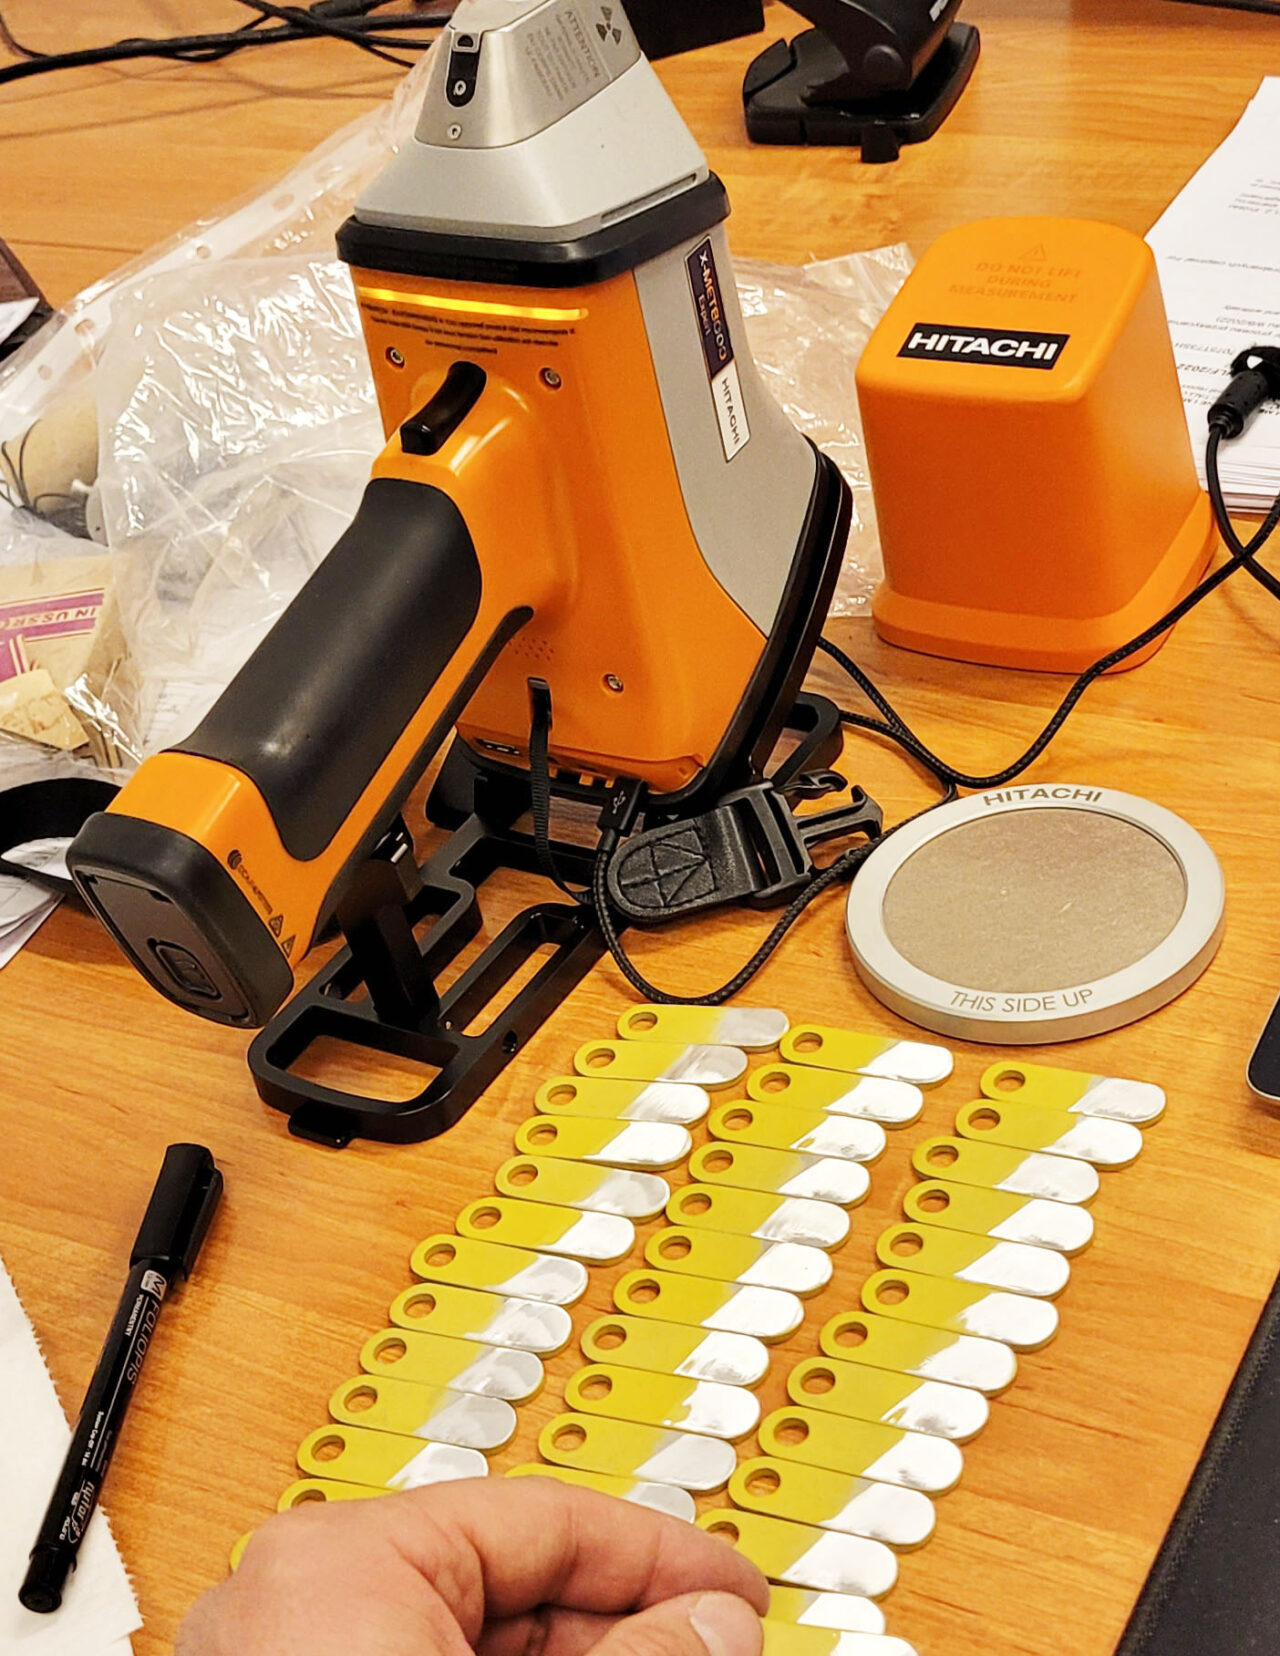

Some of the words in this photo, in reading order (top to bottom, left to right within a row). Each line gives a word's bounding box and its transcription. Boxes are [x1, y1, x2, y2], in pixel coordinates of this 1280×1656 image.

[976, 262, 1001, 272] DO
[1007, 264, 1043, 274] NOT
[987, 275, 1051, 288] DURING
[949, 284, 1077, 302] MEASUREMENT
[907, 332, 1059, 361] HITACHI
[722, 377, 740, 445] HITACHI
[984, 788, 1103, 806] HITACHI
[948, 990, 995, 1012] THIS
[1002, 997, 1056, 1013] SIDE
[1062, 989, 1094, 1009] UP
[126, 1300, 160, 1385] FOLIOPIS
